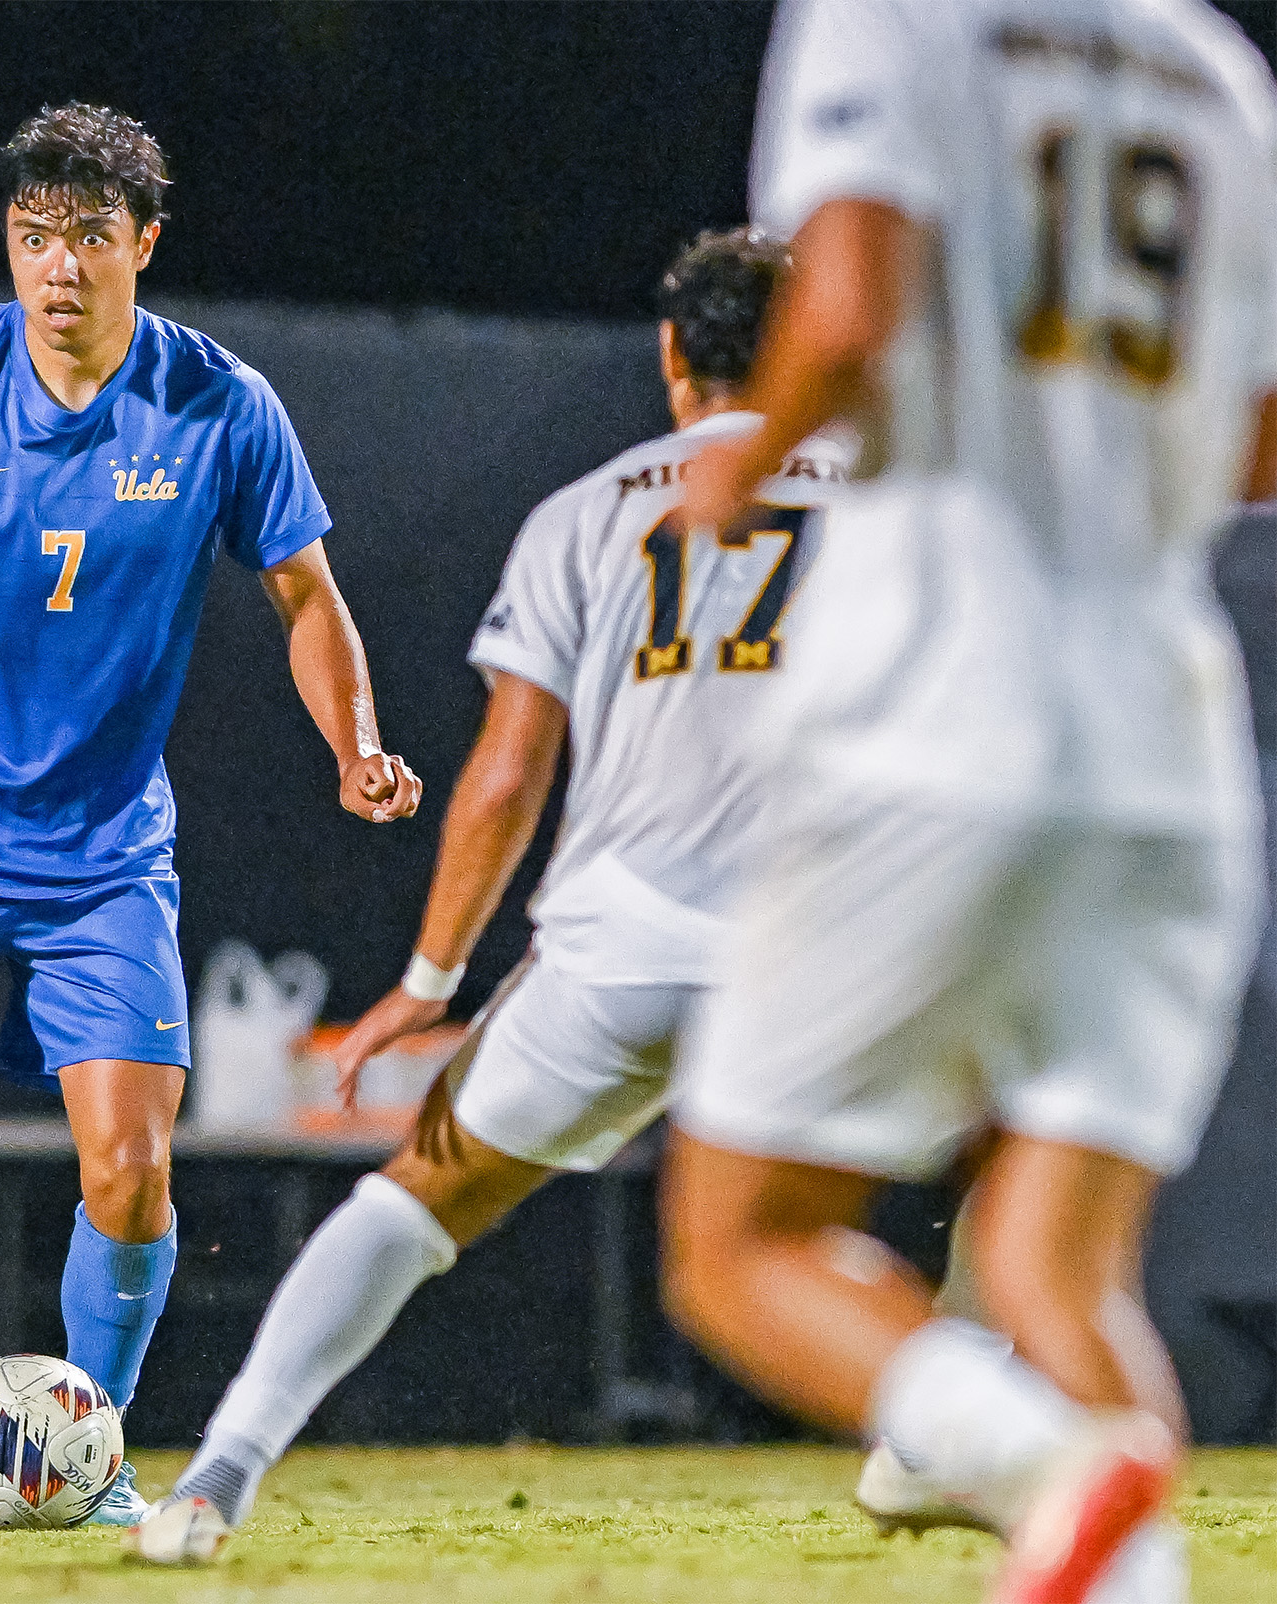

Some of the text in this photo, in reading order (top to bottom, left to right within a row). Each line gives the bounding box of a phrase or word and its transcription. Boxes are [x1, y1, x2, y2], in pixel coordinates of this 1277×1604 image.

[112, 468, 180, 502] Ucla
[41, 530, 86, 612] 7
[634, 502, 824, 684] 17
